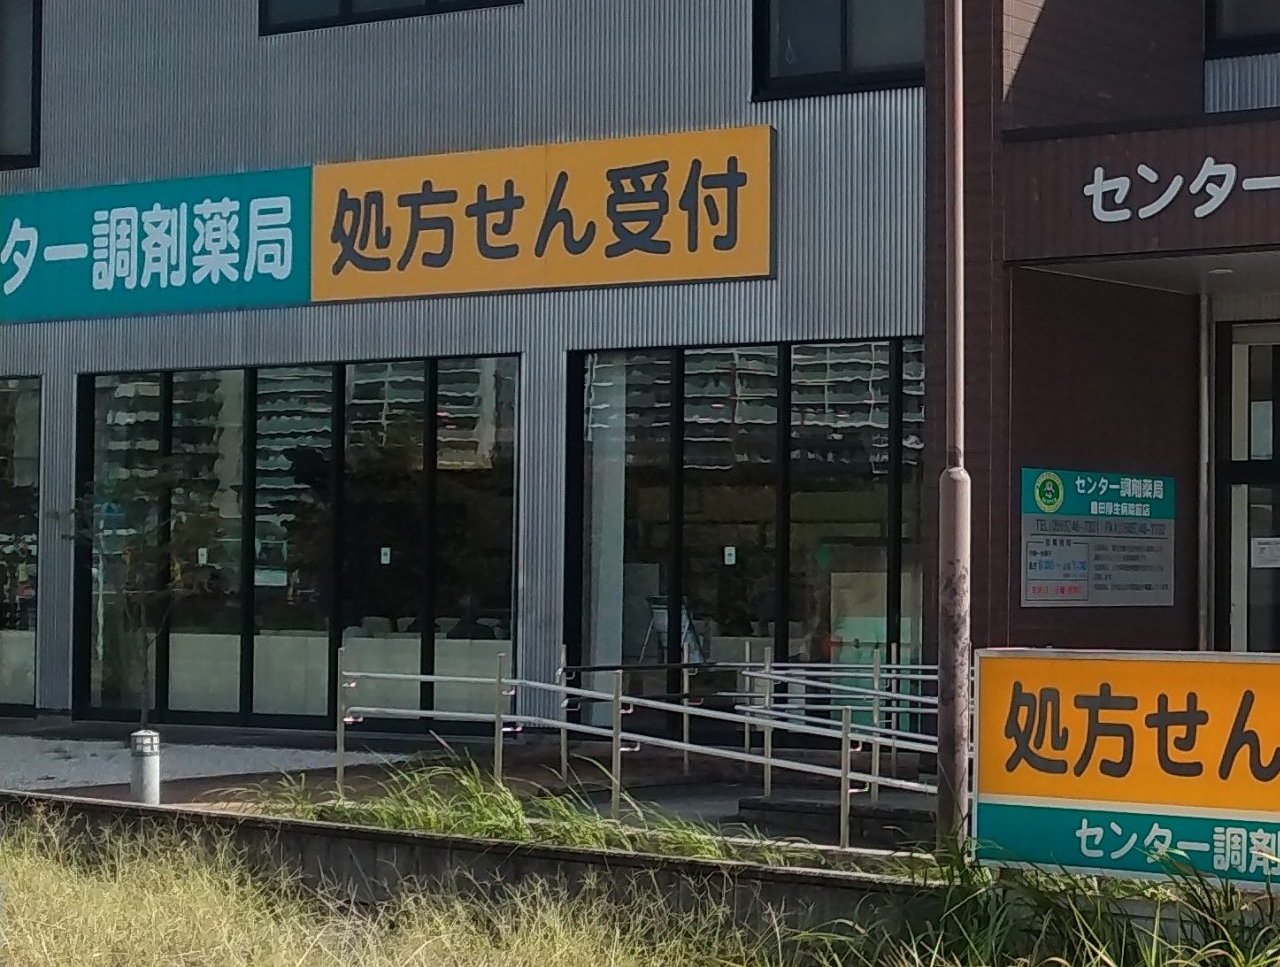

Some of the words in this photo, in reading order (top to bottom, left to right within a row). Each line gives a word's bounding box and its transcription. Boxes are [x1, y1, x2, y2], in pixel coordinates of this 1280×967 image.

[0, 196, 292, 295] ター調剤薬局
[331, 155, 748, 275] 処方せん受付
[1075, 475, 1164, 500] センター調剤薬局
